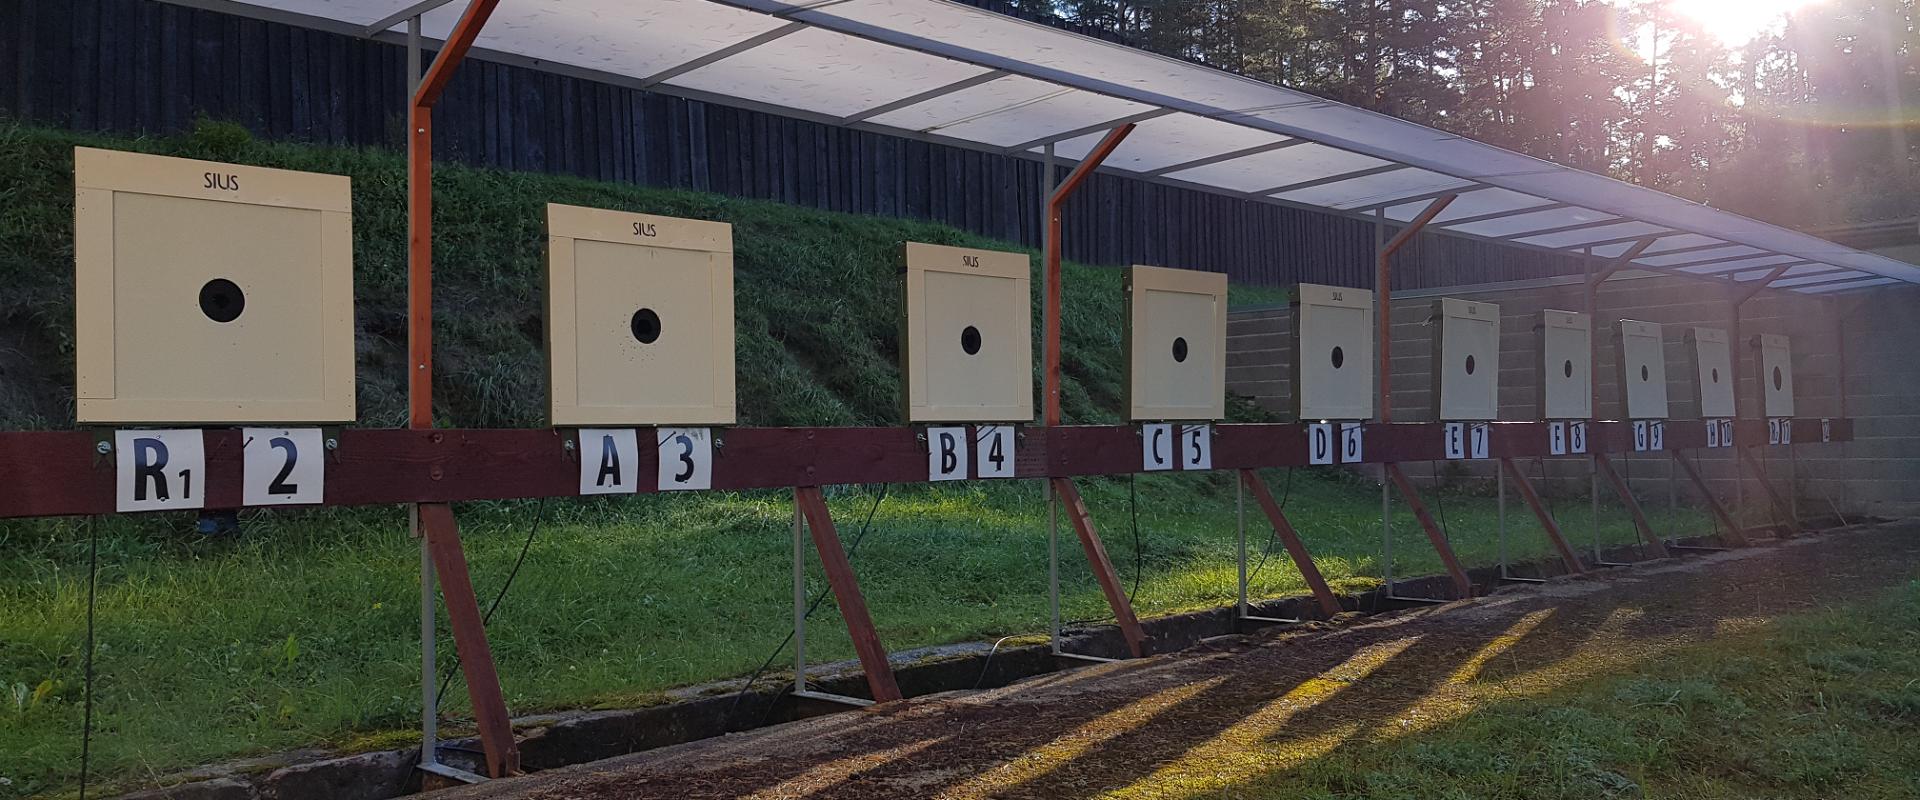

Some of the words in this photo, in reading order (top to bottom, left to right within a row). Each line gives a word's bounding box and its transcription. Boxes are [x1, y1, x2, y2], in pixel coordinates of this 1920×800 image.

[204, 172, 239, 191] SIUS
[632, 222, 657, 237] SIUS
[1152, 428, 1164, 465] C
[1191, 430, 1202, 465] 5
[1316, 427, 1326, 460] D
[1348, 428, 1356, 457] 6
[1452, 426, 1459, 455] E
[1476, 427, 1483, 455] 7
[1555, 425, 1560, 452] F
[1574, 424, 1581, 450] 8
[1637, 423, 1644, 448] G
[1653, 424, 1659, 448] 9
[268, 437, 298, 495] 2
[596, 434, 622, 487] A
[674, 434, 695, 483] 3
[940, 432, 957, 474] B
[988, 432, 1004, 471] 4
